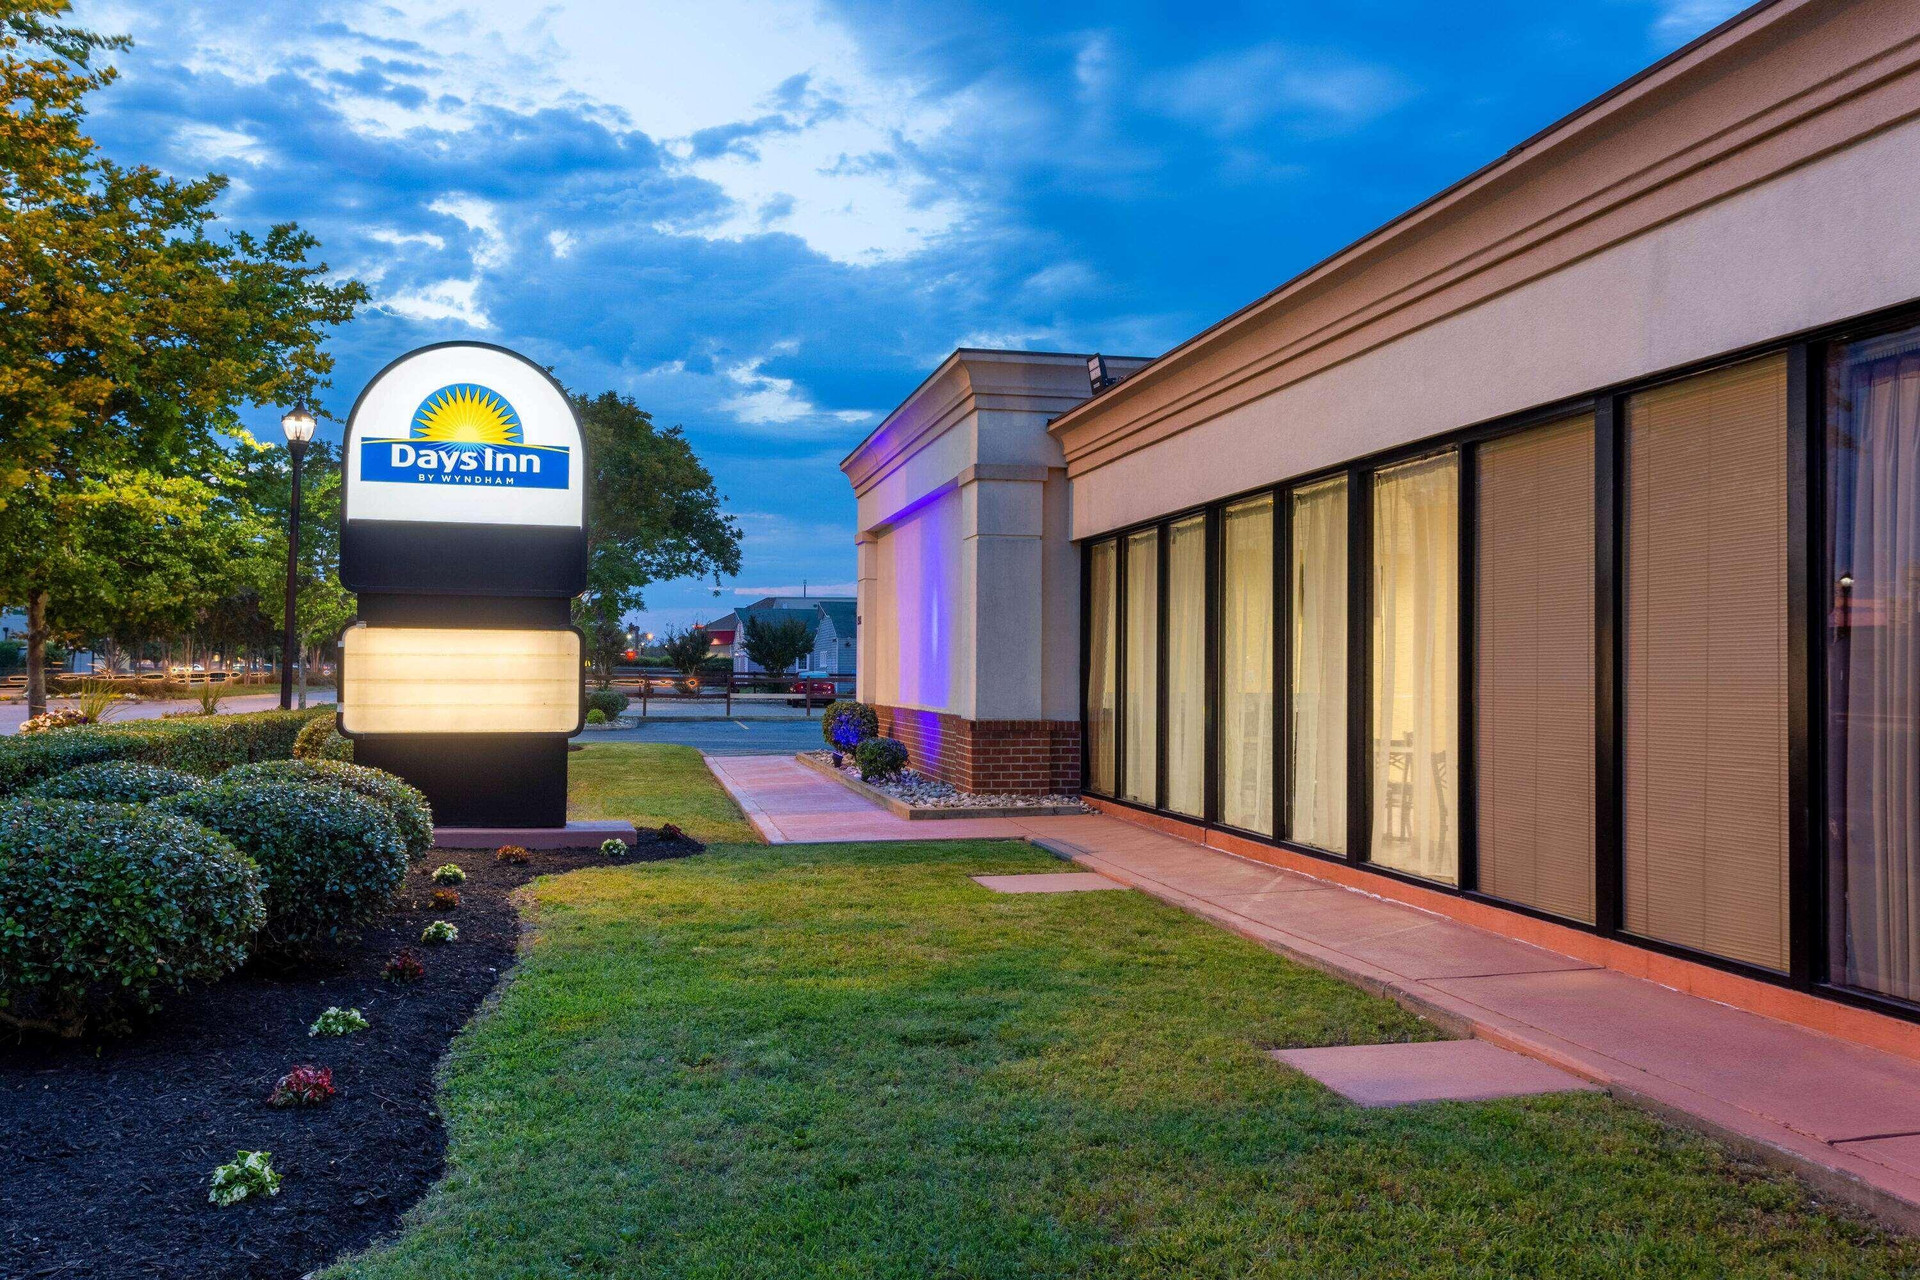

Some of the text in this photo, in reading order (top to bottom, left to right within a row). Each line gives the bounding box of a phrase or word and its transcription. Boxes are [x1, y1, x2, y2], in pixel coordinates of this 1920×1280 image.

[391, 443, 541, 473] Days Inn
[418, 473, 515, 485] BY WYNDHAM
